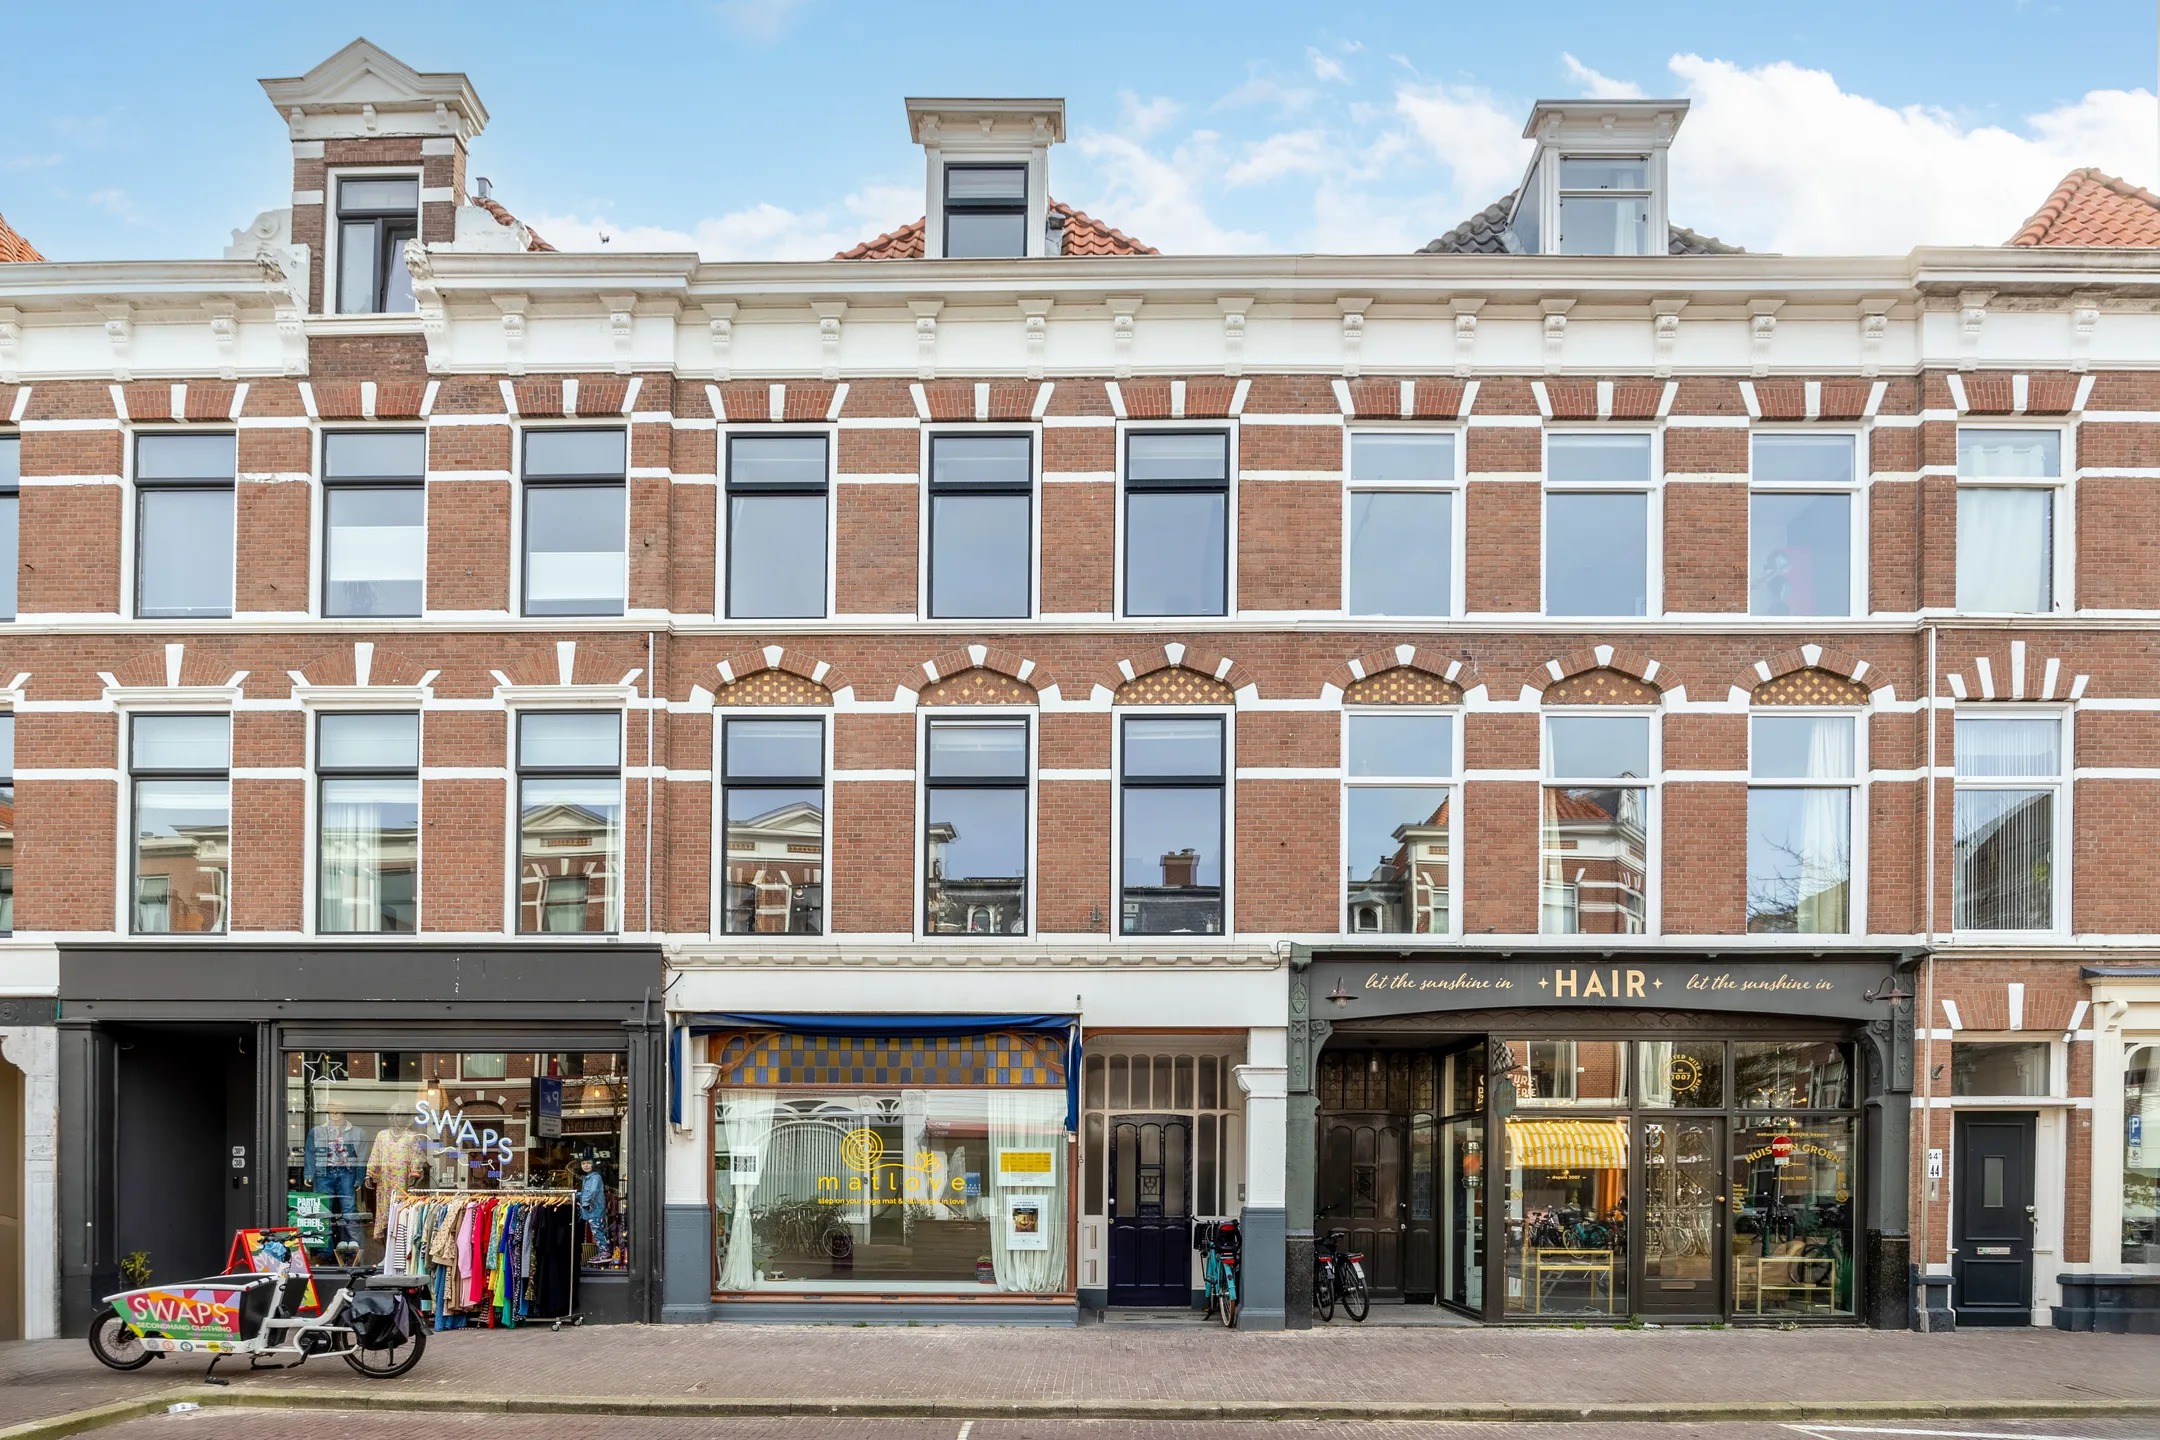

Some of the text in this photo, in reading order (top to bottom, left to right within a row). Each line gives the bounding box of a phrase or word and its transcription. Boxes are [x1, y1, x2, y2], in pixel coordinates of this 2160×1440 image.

[1365, 972, 1514, 991] let the sunshine in
[1555, 969, 1647, 998] HAIR
[1686, 973, 1835, 992] let the sunshine in
[414, 1100, 513, 1165] SWAPS
[1744, 1146, 1773, 1164] HUIS
[1802, 1144, 1841, 1163] GROEN
[1930, 1164, 1940, 1176] 44
[818, 1173, 966, 1191] matlove
[818, 1197, 834, 1205] step
[297, 1218, 320, 1227] DIEREN
[133, 1297, 230, 1326] SWAPS
[135, 1321, 232, 1333] SECONDHAND CLOTHING
